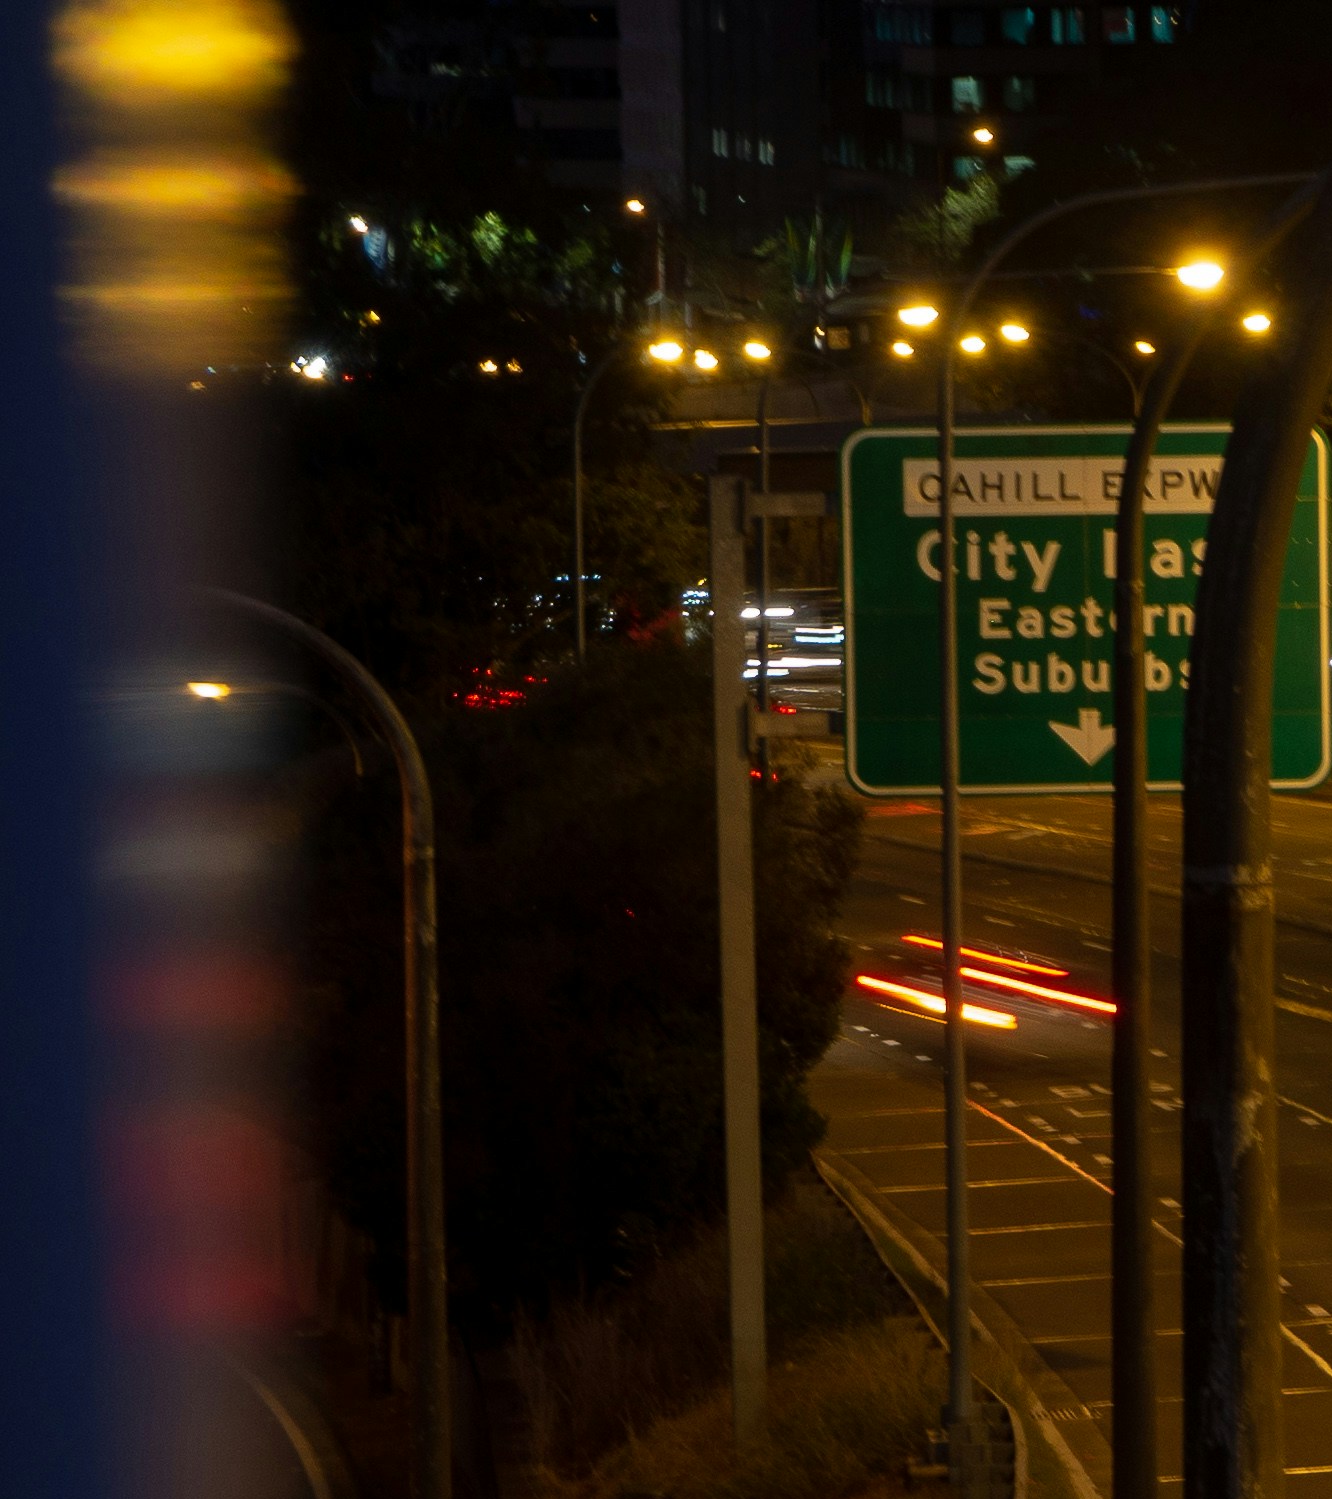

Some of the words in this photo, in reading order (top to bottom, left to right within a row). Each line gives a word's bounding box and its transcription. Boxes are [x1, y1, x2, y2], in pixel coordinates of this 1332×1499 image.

[917, 470, 1081, 503] CAHILL
[916, 528, 1062, 593] City
[979, 597, 1197, 640] Eastrn
[972, 651, 1192, 695] Subub
